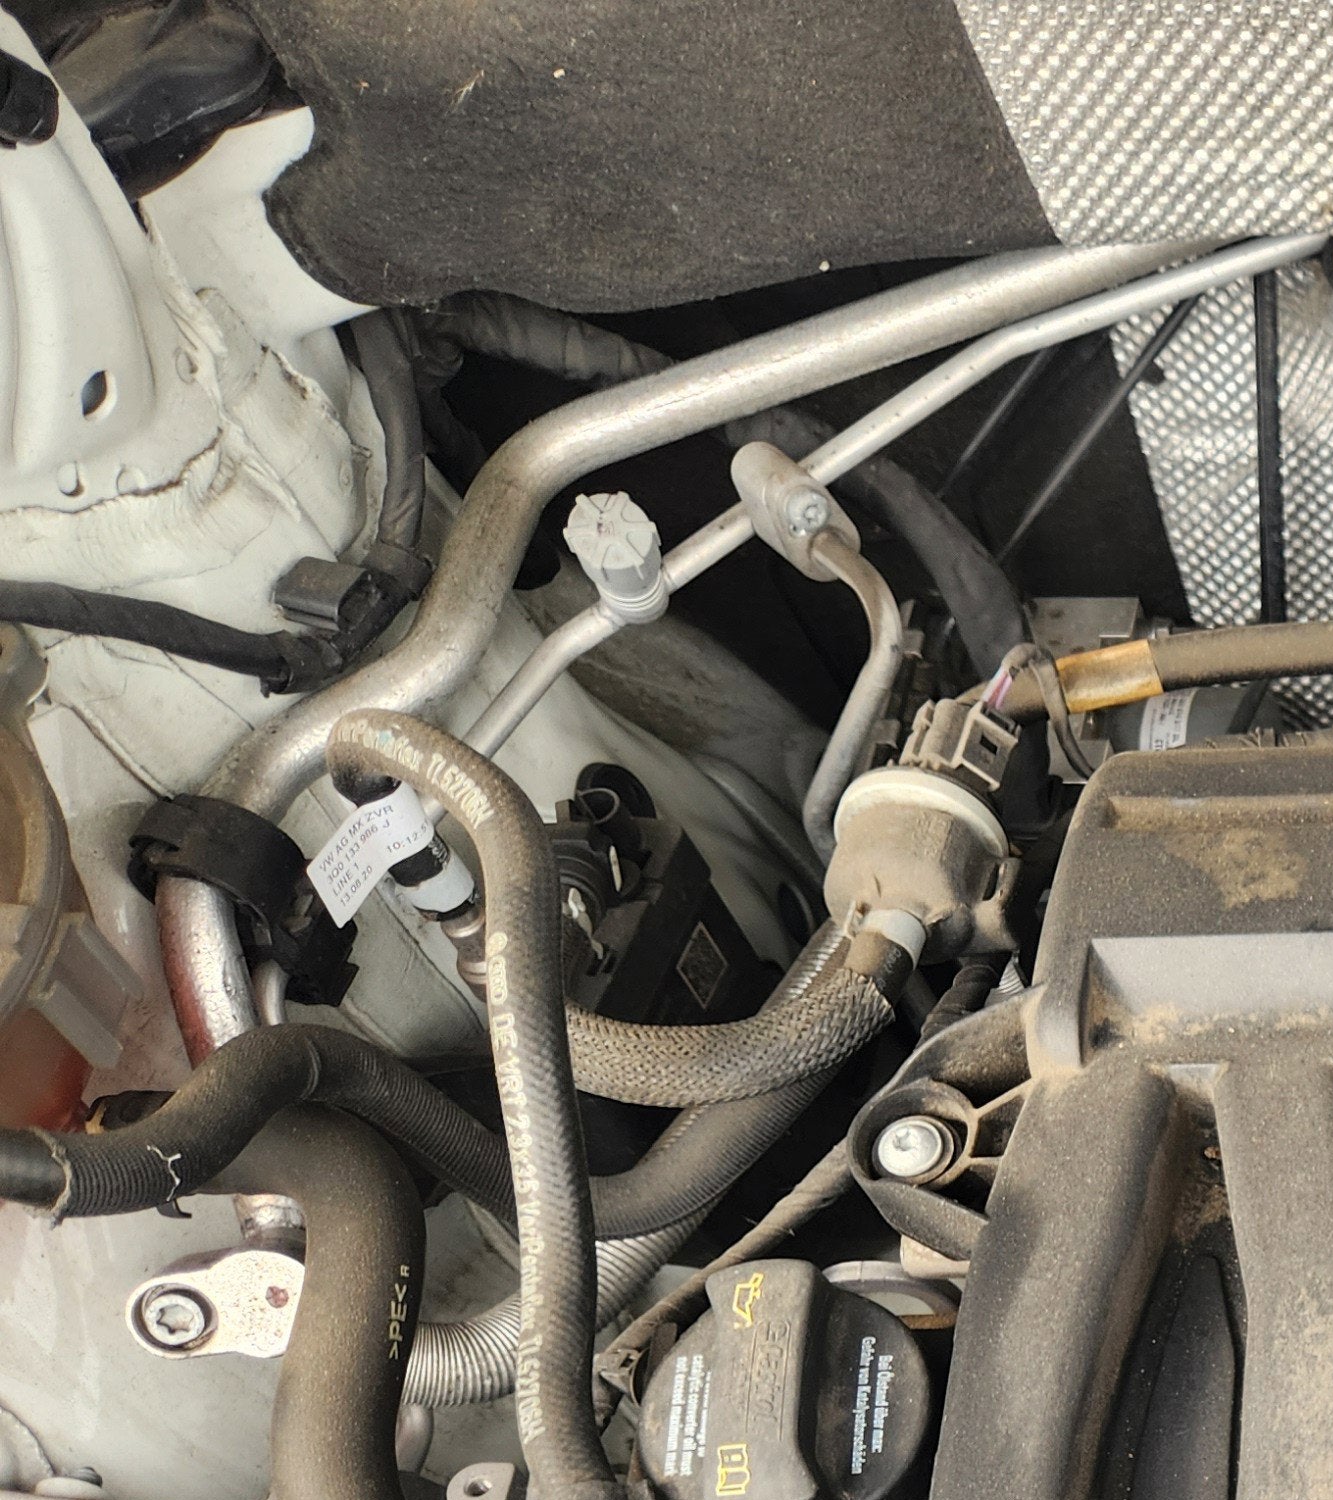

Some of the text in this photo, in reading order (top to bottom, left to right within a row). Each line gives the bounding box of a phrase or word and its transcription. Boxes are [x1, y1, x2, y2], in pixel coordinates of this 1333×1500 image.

[335, 837, 349, 854] AG
[332, 870, 353, 898] LINE
[676, 1356, 687, 1373] not
[860, 1336, 876, 1366] Gefahr
[878, 1354, 894, 1370] Bei
[674, 1373, 684, 1404] exceed
[754, 1344, 783, 1423] Castrol
[858, 1367, 870, 1384] von
[667, 1405, 682, 1452] maximum
[686, 1393, 698, 1436] converter
[681, 1451, 693, 1476] must
